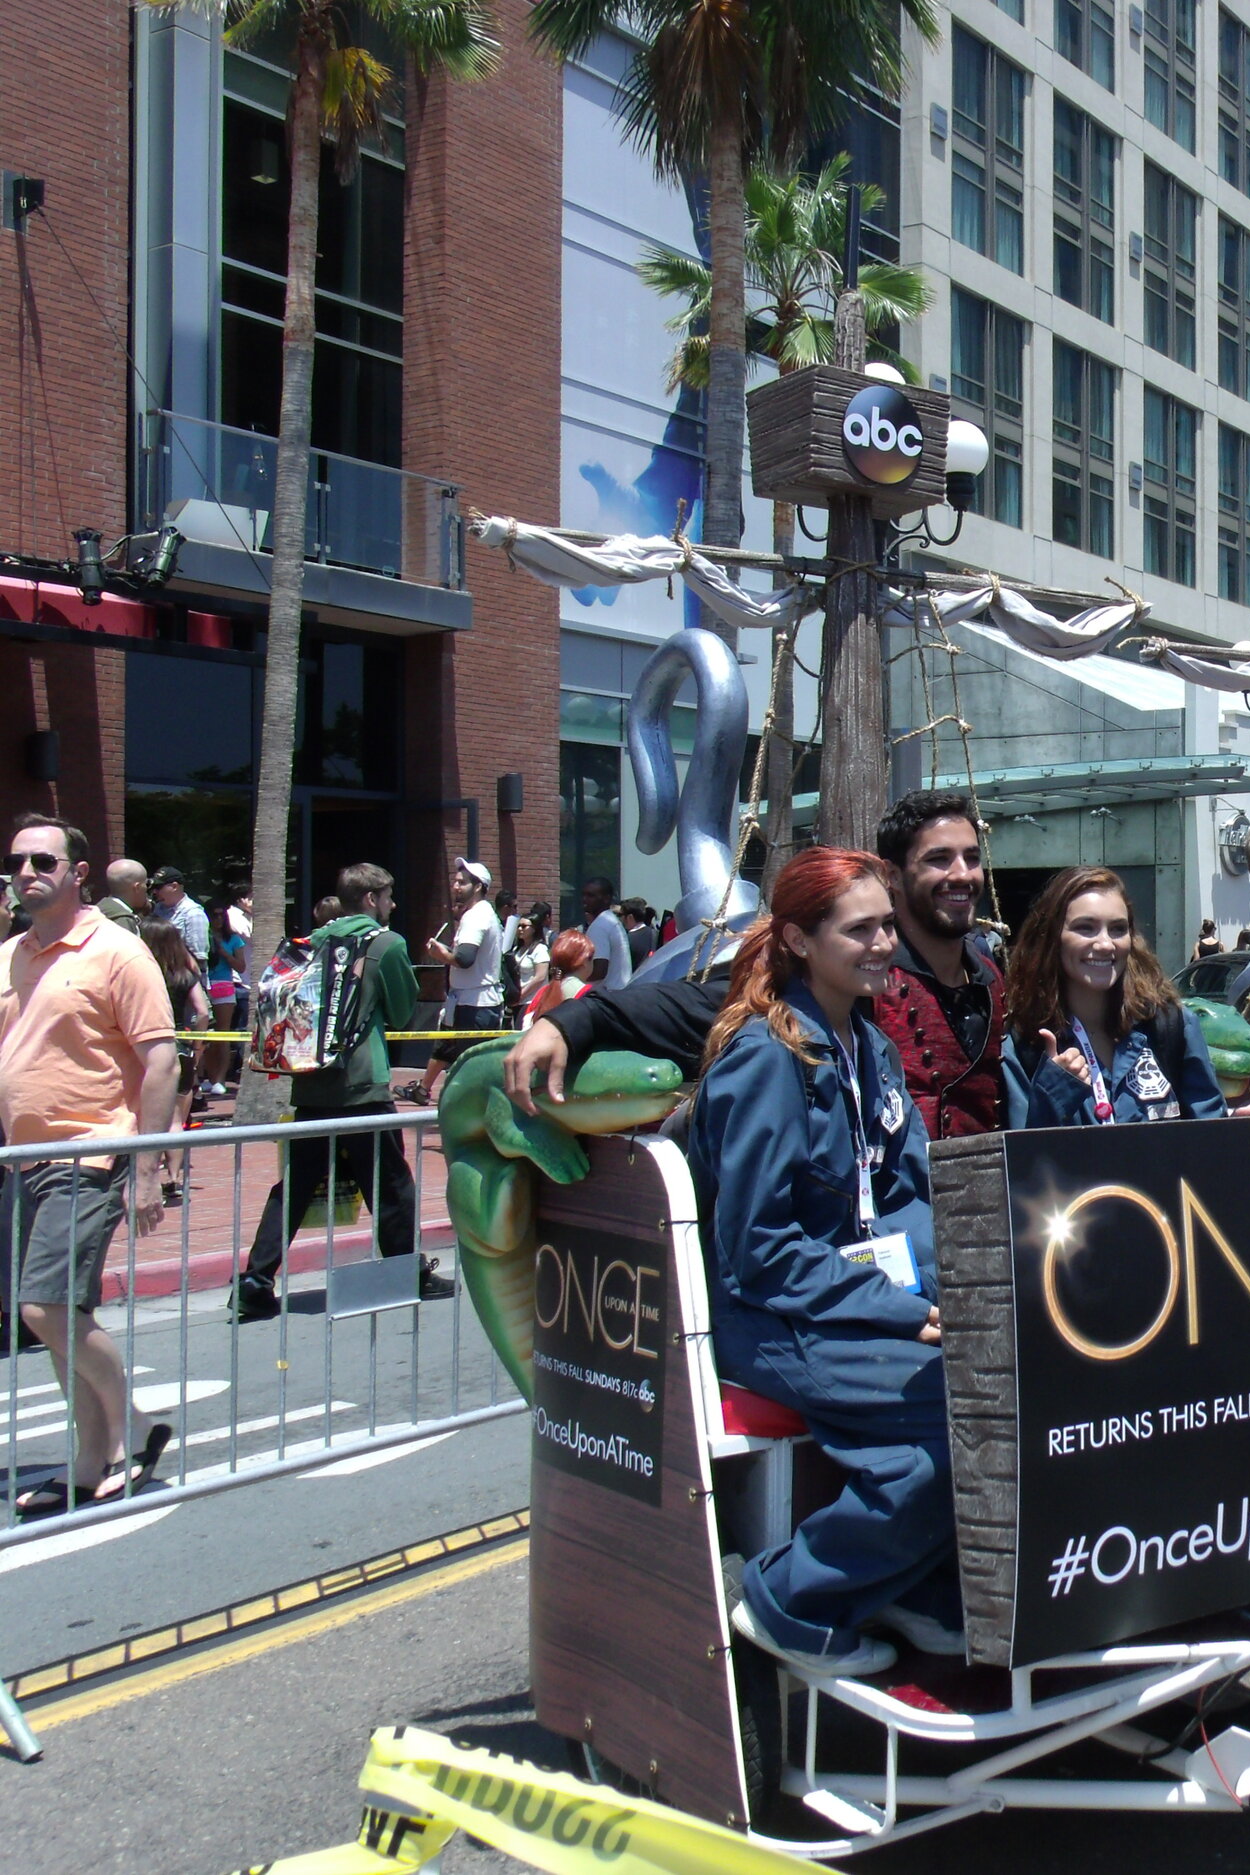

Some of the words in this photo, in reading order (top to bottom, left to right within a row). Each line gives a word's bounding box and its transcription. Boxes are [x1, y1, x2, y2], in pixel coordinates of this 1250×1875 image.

[843, 406, 923, 457] abc
[535, 1244, 660, 1359] ONCE
[604, 1295, 628, 1313] UPON
[629, 1301, 637, 1315] A
[641, 1304, 660, 1322] TIME
[553, 1358, 569, 1376] THIS
[568, 1364, 584, 1382] FALL
[585, 1369, 621, 1393] SUNDAYS
[638, 1387, 656, 1404] abc
[1049, 1411, 1154, 1457] RETURNS
[1159, 1401, 1208, 1435] THIS
